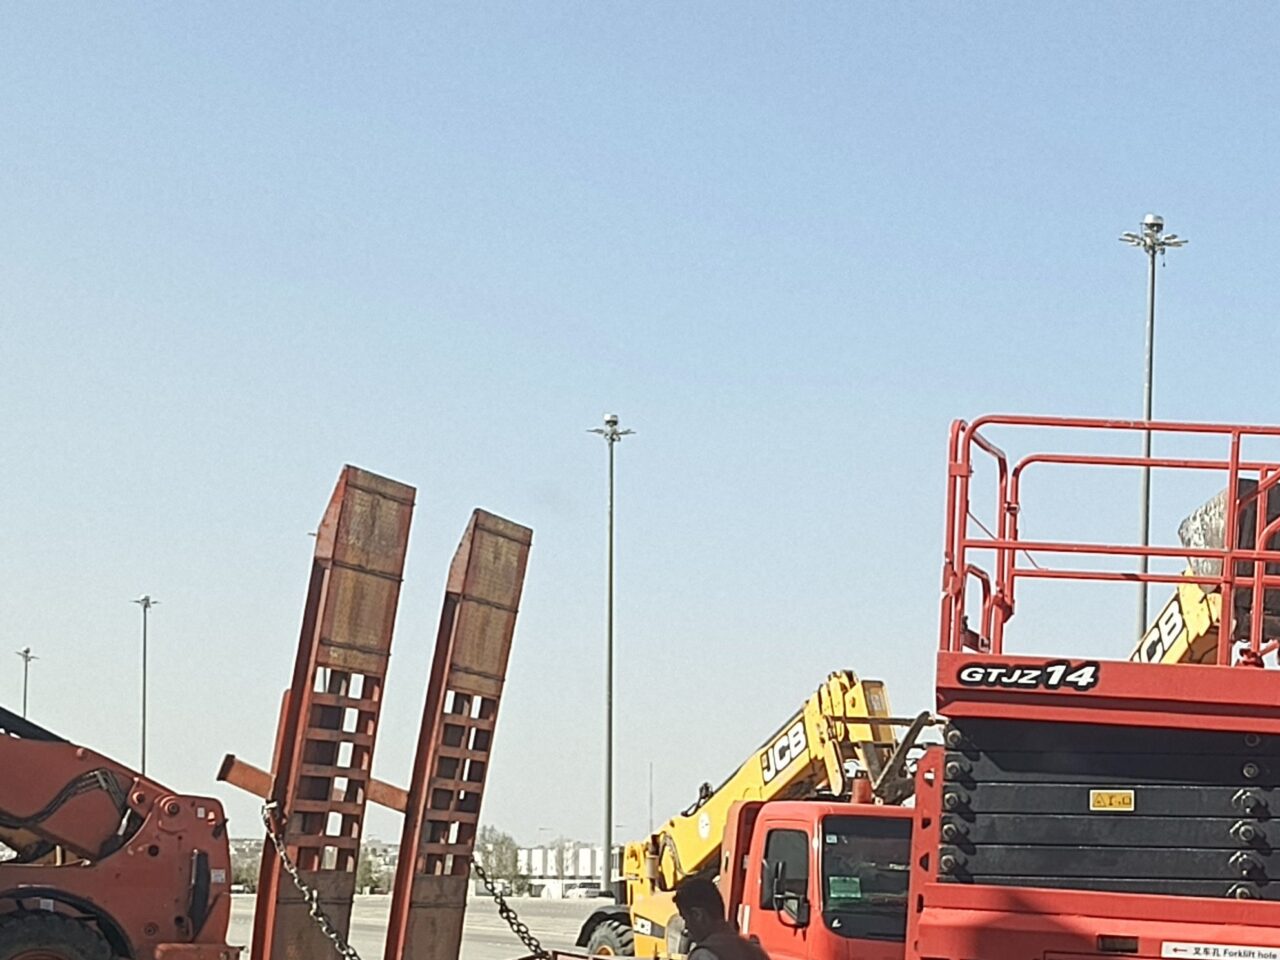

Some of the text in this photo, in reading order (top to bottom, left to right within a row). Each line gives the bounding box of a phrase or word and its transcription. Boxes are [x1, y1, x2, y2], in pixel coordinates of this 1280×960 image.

[1132, 600, 1184, 663] CB
[761, 721, 807, 783] JCB
[1223, 948, 1256, 959] Forklift
[1257, 950, 1278, 960] hole
